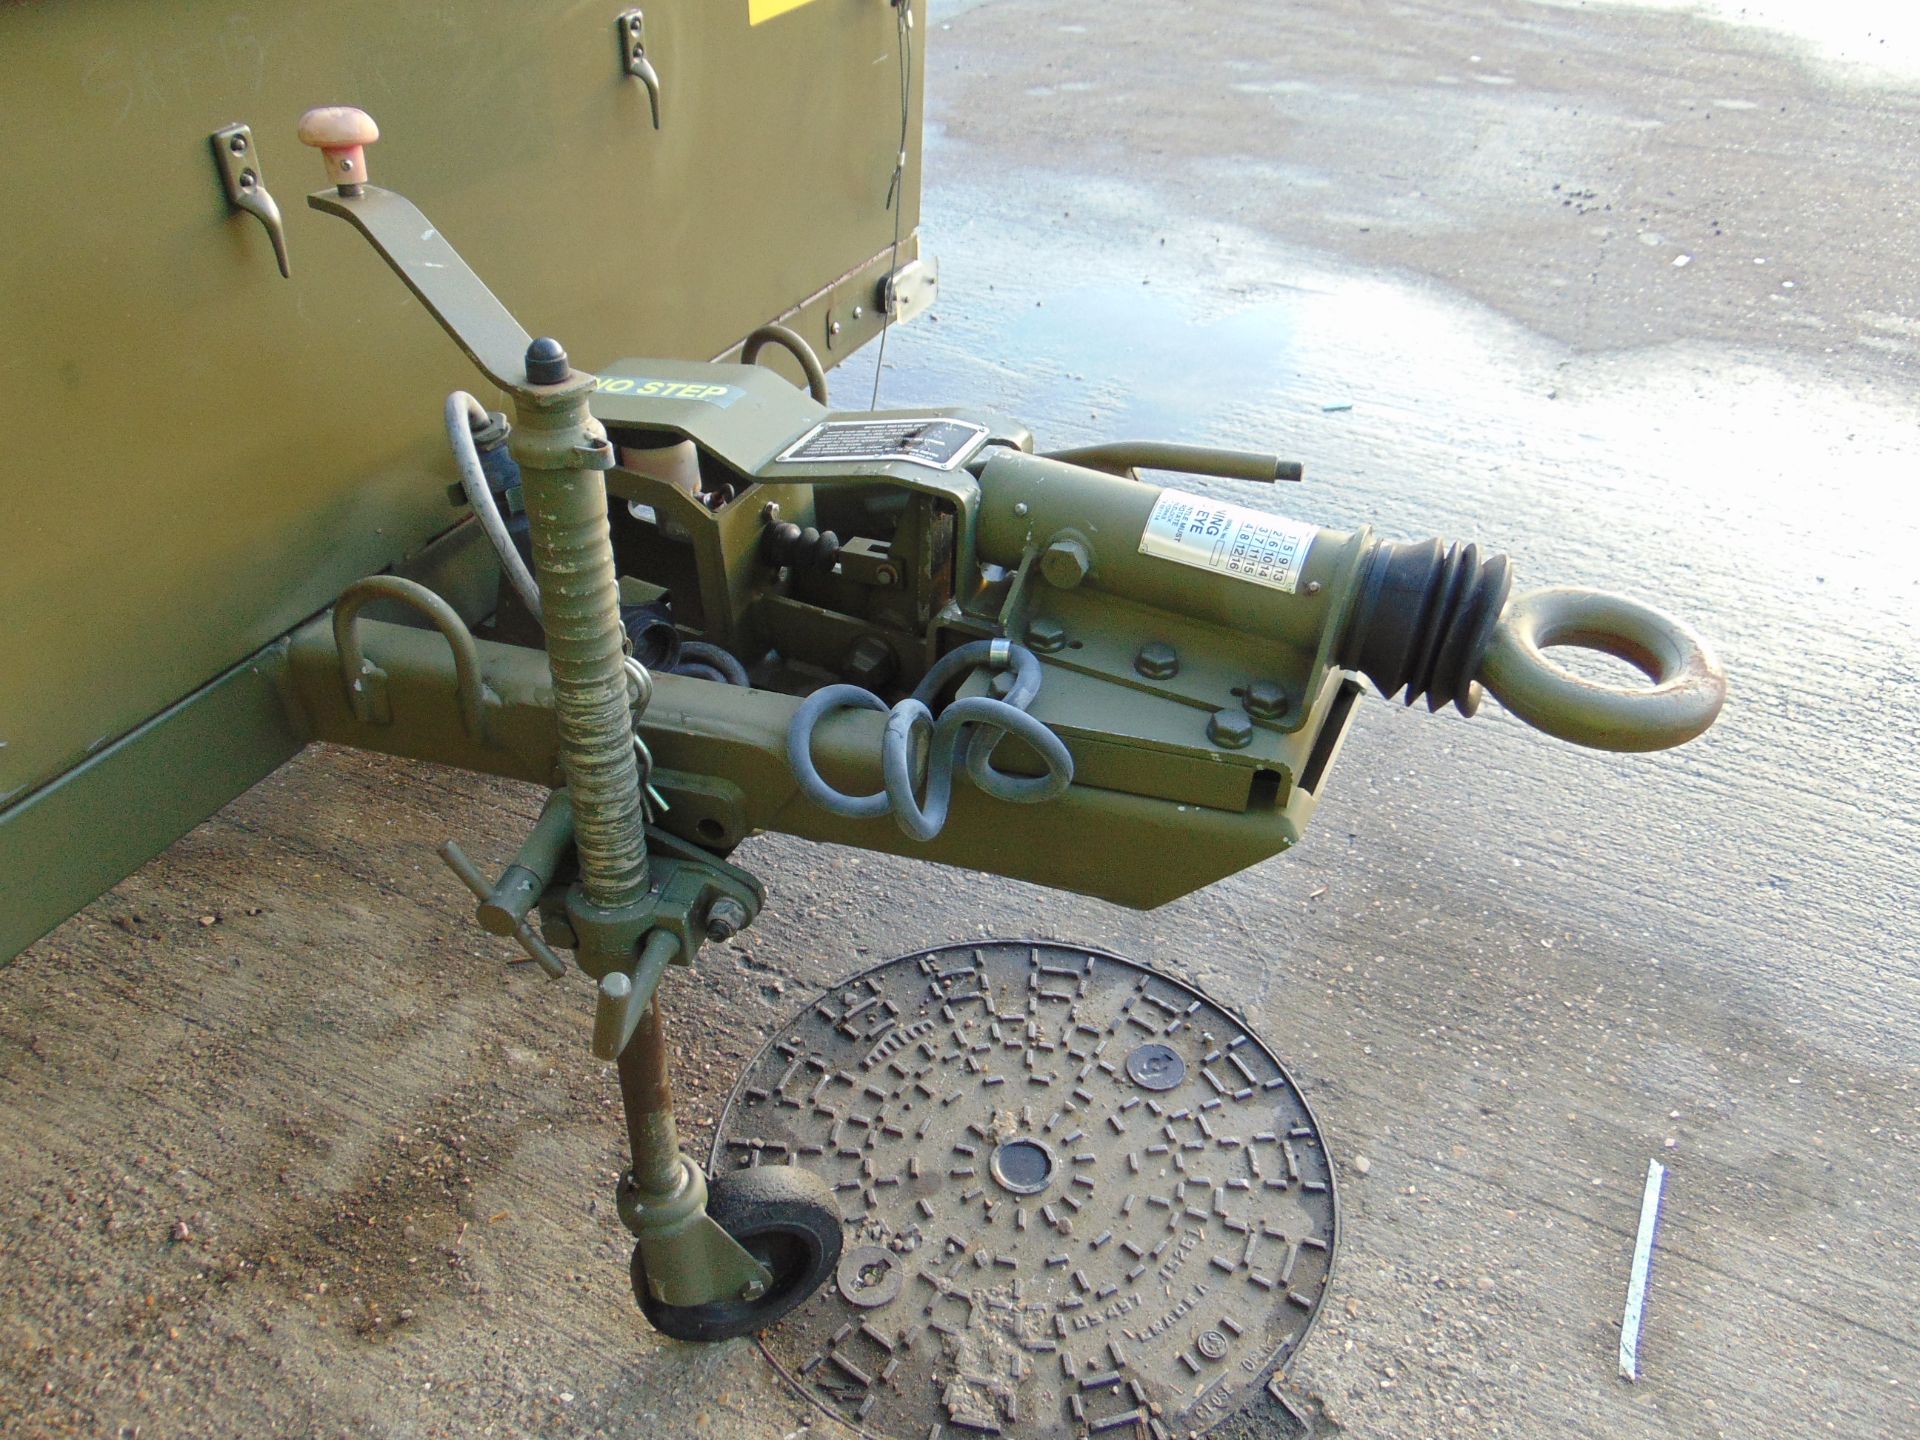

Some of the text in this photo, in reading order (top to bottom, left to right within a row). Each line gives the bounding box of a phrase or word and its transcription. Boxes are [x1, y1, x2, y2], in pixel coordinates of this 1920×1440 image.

[595, 377, 728, 398] NO STEP
[1190, 510, 1210, 535] EYE
[1239, 533, 1250, 541] 8
[1234, 544, 1246, 556] 12
[1268, 540, 1279, 548] 6
[1283, 544, 1293, 552] 5
[1248, 548, 1260, 560] 11
[1262, 552, 1274, 564] 10
[1229, 557, 1240, 570] 16
[1279, 557, 1289, 565] 9
[1243, 561, 1255, 574] 15
[1258, 565, 1270, 577] 14
[1273, 570, 1284, 582] 13
